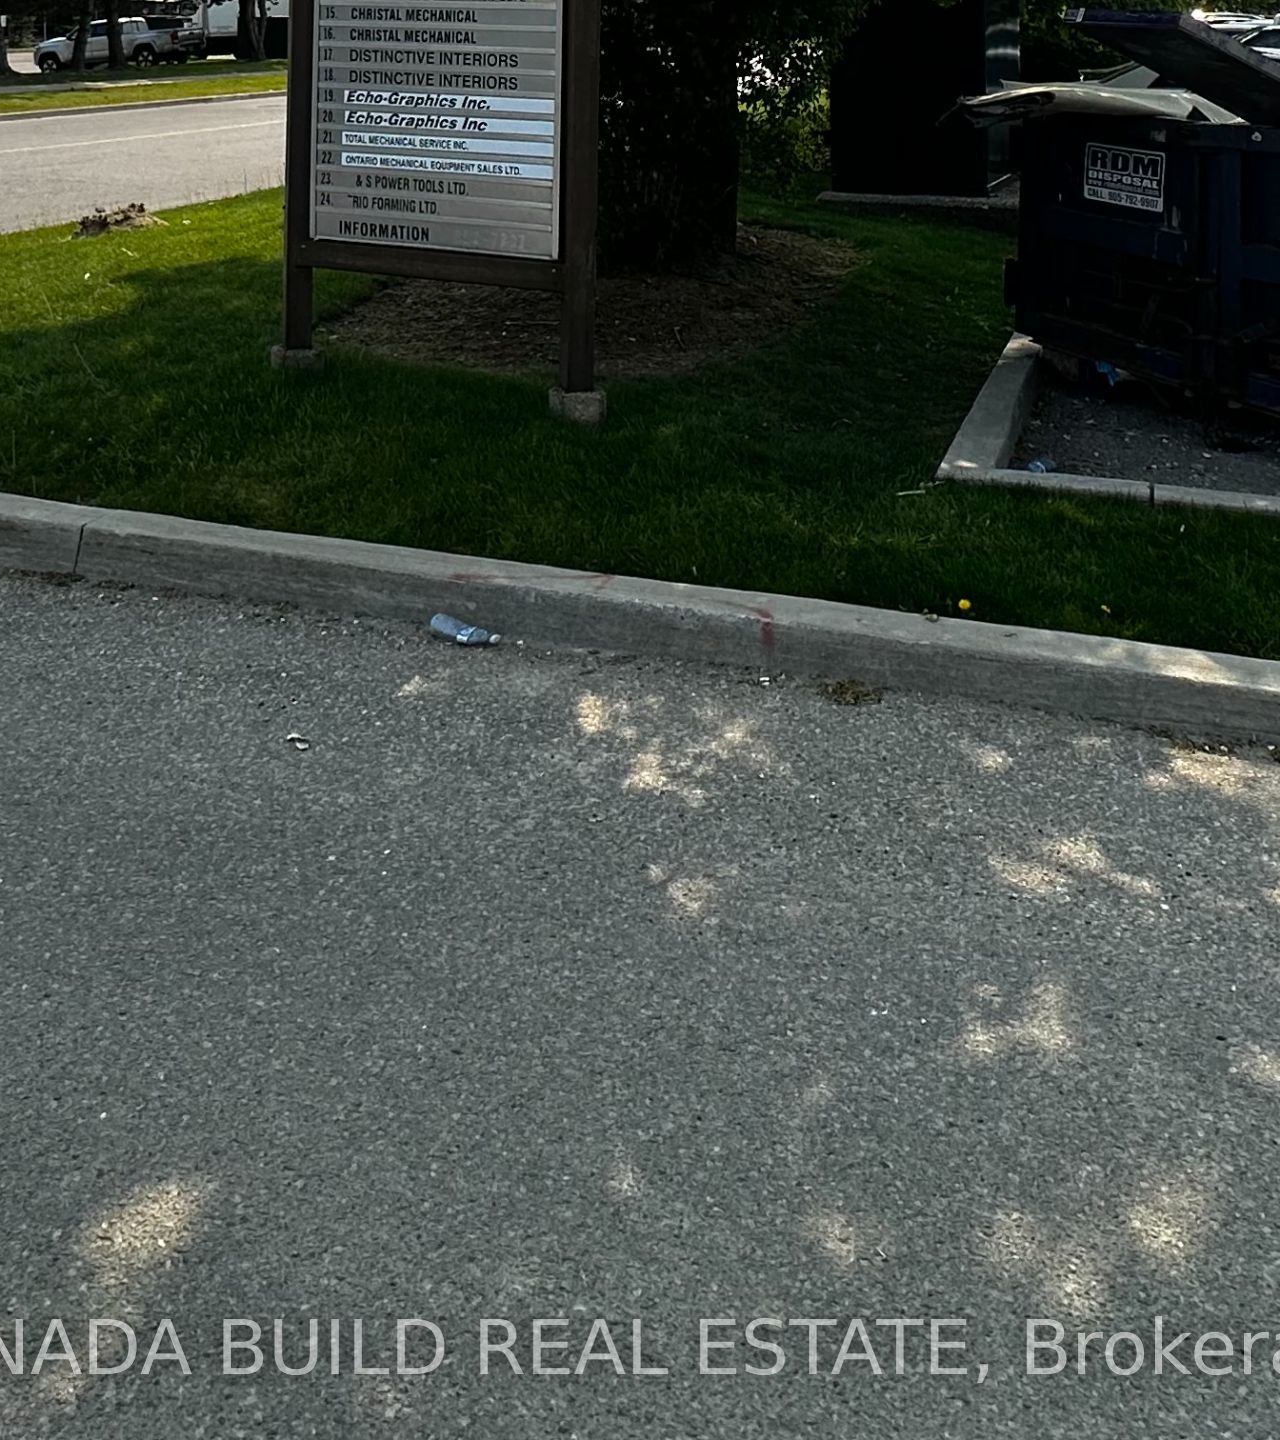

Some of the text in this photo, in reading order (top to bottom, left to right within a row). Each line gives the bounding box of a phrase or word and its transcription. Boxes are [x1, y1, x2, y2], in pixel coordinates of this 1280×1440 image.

[351, 8, 402, 20] CHRISTAL
[406, 9, 478, 22] MECHANICAL
[350, 28, 400, 41] CHRISTAL
[404, 30, 476, 44] MECHANICAL
[349, 49, 435, 64] DISTINCTIVE
[440, 51, 519, 68] INTERIORS
[349, 70, 434, 86] DISTINCTIVE
[439, 73, 518, 90] INTERIORS
[347, 90, 457, 108] Echo-Graphics
[461, 96, 491, 110] Inc.
[346, 111, 458, 129] Echo-Graphics
[461, 117, 488, 131] Inc
[345, 134, 367, 144] TOTAL
[368, 135, 417, 147] MECHANICAL
[419, 138, 451, 149] SERVICE
[453, 141, 469, 150] INC.
[345, 155, 379, 165] ONTARIO
[380, 157, 428, 169] MECHANICAL
[430, 160, 475, 172] EQUIPMENT
[477, 163, 503, 174] SALES
[505, 165, 522, 175] LTD.
[1089, 146, 1161, 180] RDM
[356, 174, 362, 187] &
[365, 175, 372, 188] S
[375, 175, 410, 191] POWER
[413, 178, 444, 193] TOOLS
[447, 181, 469, 196] LTD.
[1088, 170, 1159, 189] DISPOSAL
[372, 197, 416, 213] FORMING
[419, 201, 440, 215] LTD.
[339, 220, 430, 241] INFORMATION
